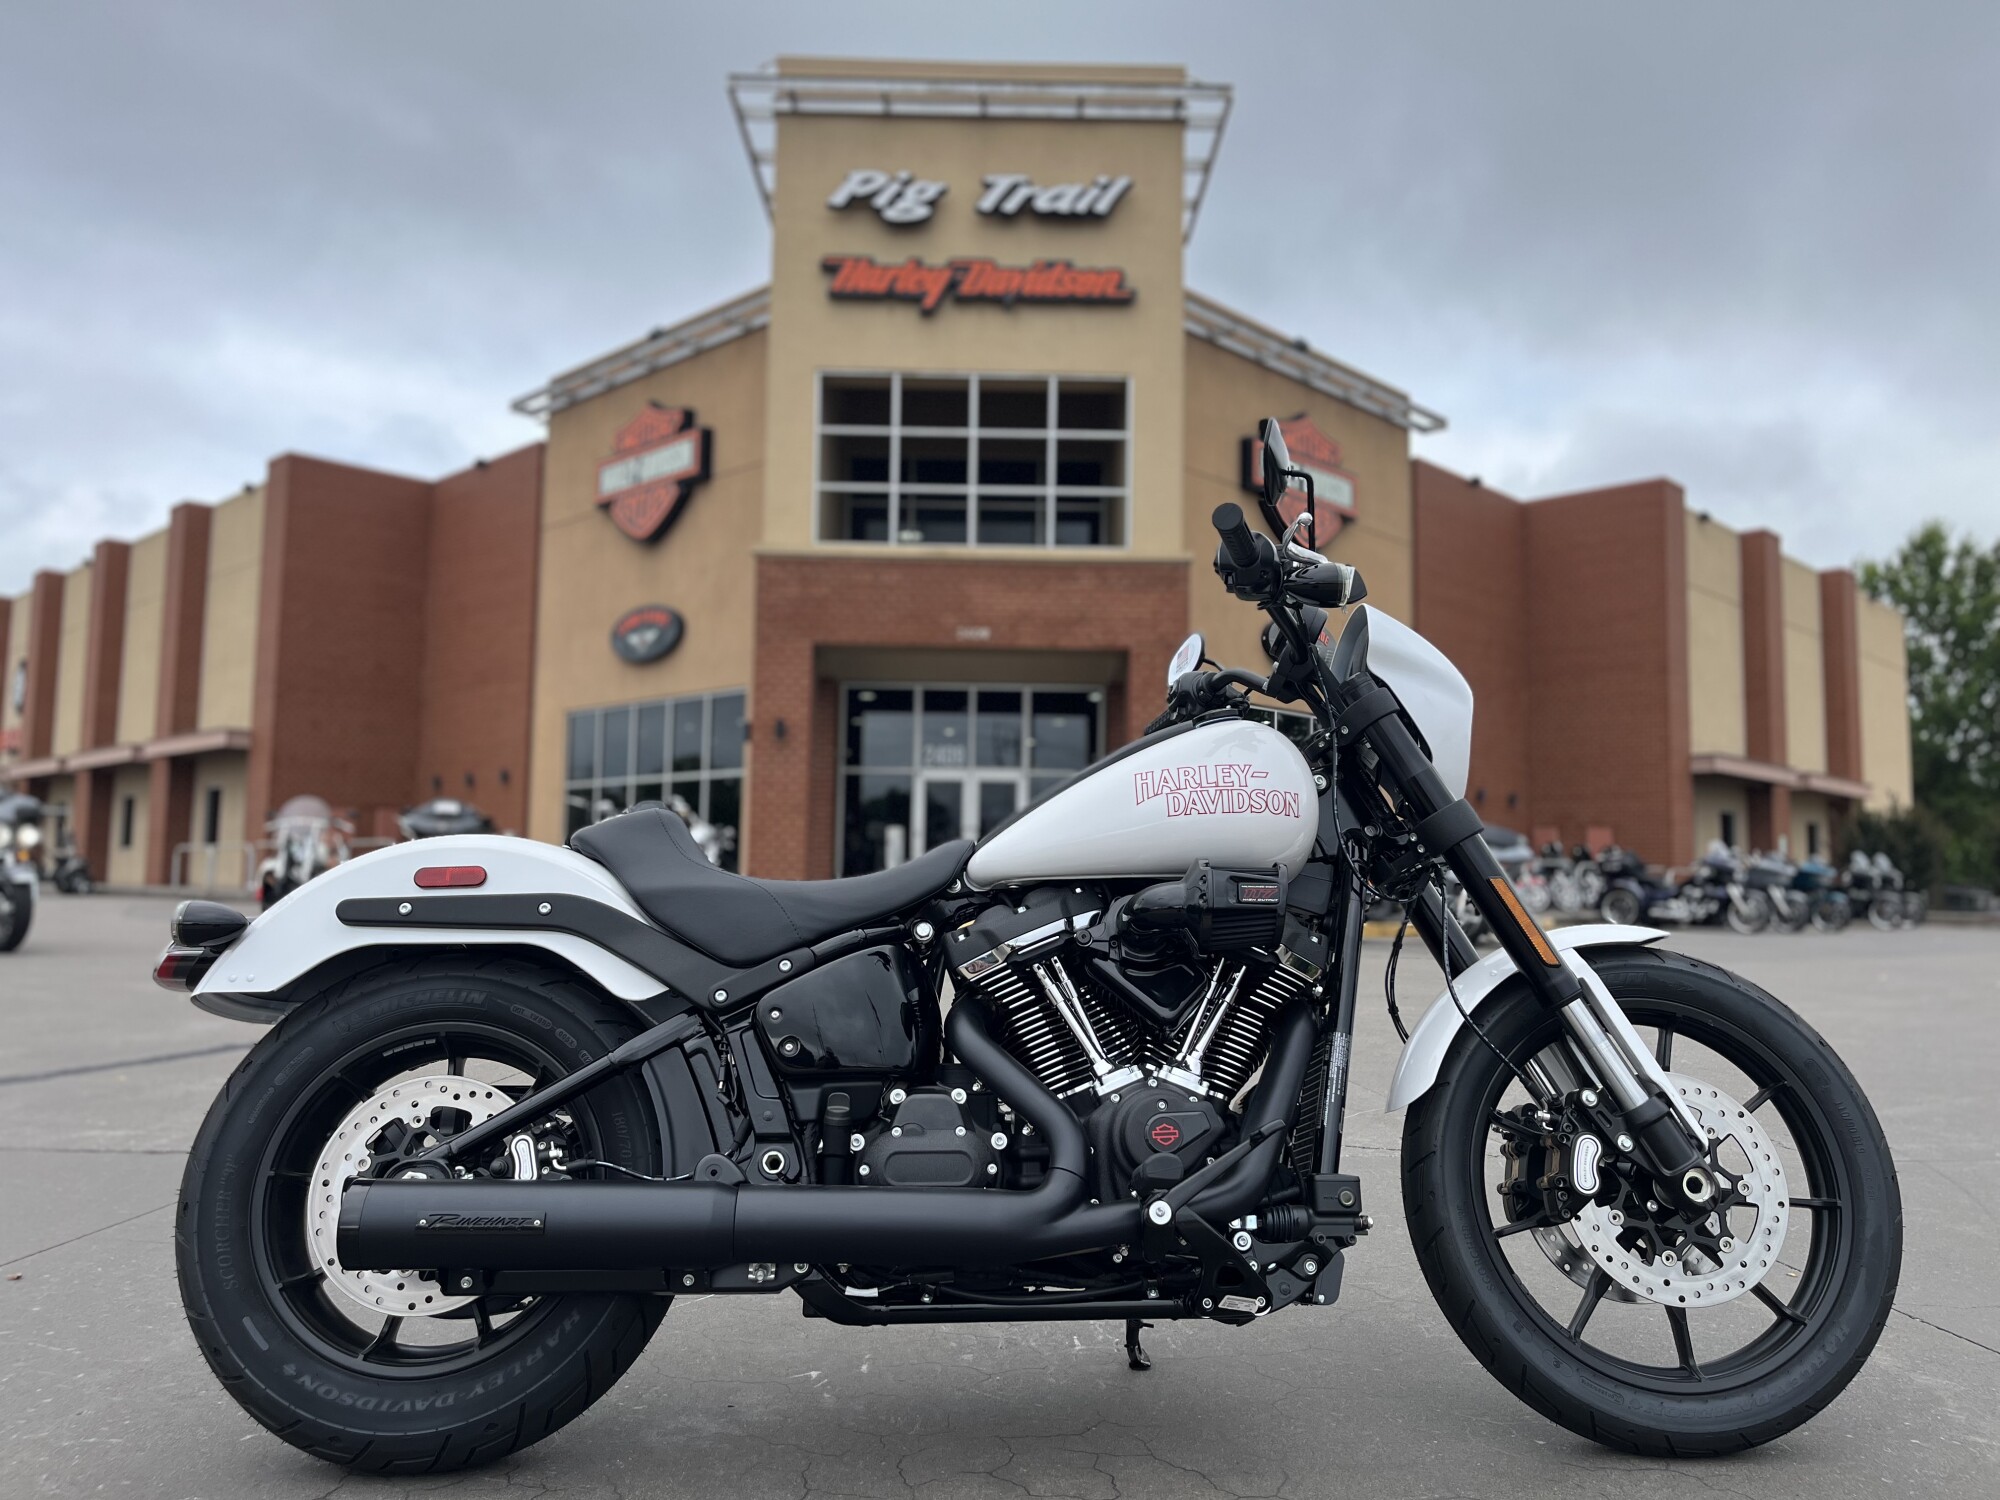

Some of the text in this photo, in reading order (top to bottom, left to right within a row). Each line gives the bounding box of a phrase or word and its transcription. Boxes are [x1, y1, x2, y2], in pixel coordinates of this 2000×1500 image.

[829, 169, 1132, 223] Pig Trail
[1134, 764, 1269, 806] HARLEY-
[1166, 788, 1300, 818] DAVIDSON
[369, 991, 488, 1018] MICHELIN
[214, 1189, 240, 1291] SCORCHER
[427, 1213, 533, 1229] RINEHART
[294, 1309, 582, 1413] HARLEY-DAVIDSON
